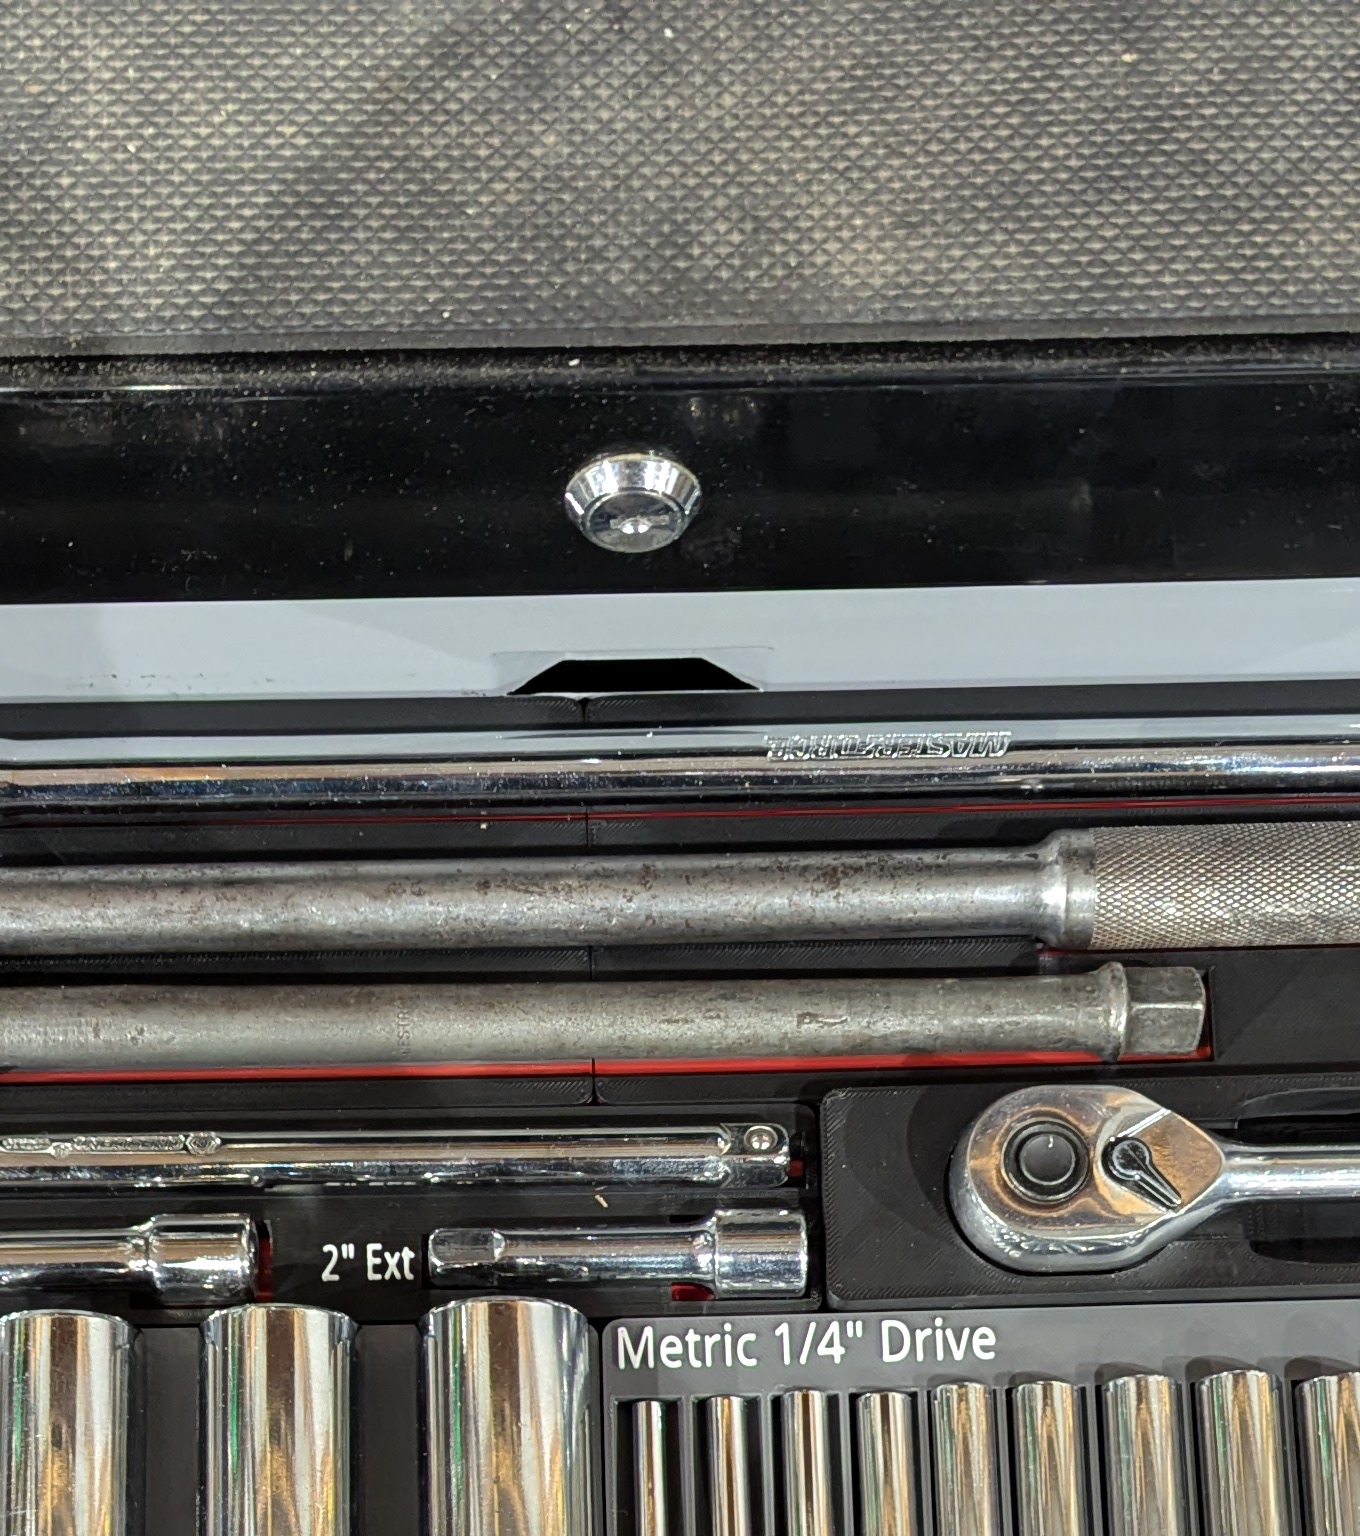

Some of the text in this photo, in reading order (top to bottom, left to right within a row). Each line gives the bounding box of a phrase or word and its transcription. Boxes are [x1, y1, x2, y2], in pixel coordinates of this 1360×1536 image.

[322, 1243, 415, 1281] 2" Ext
[618, 1318, 996, 1369] Metric 1/4" Drive
